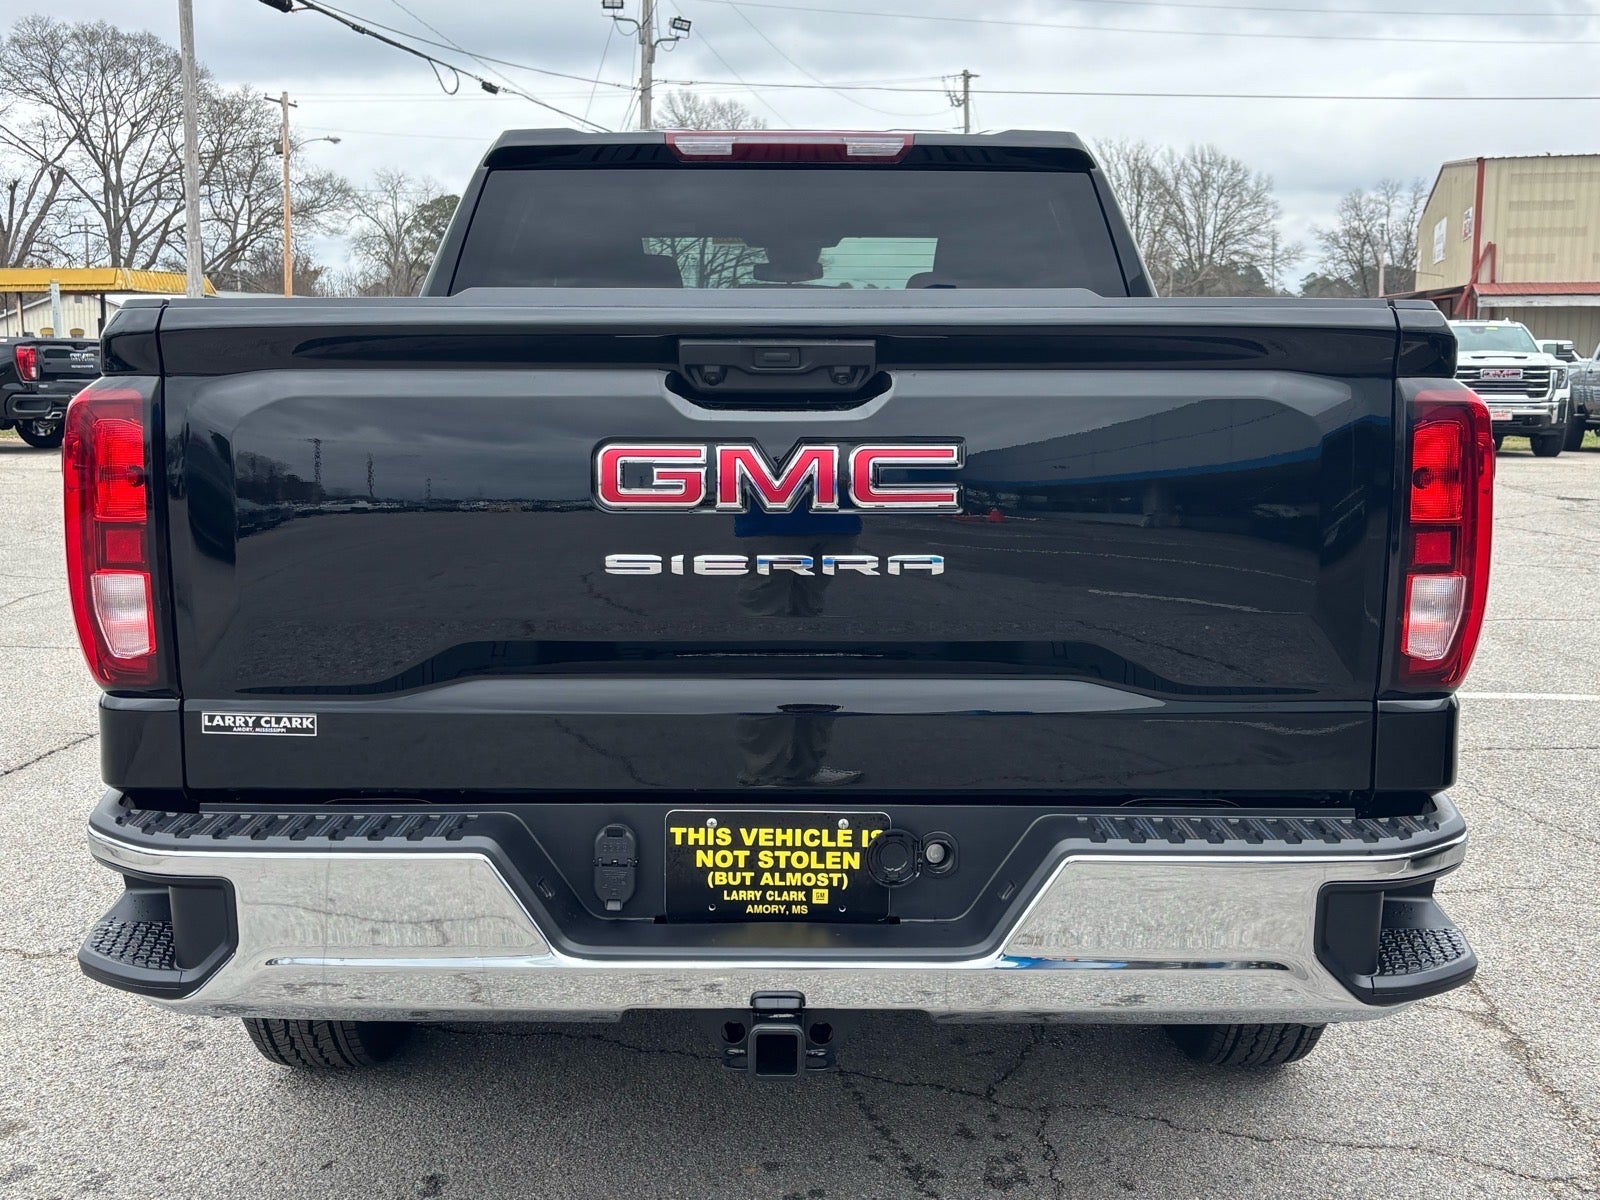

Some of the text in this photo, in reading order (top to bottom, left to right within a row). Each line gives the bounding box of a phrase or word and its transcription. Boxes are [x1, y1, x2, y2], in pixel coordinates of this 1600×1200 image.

[597, 443, 964, 510] GMC
[604, 553, 946, 577] SIERRA
[204, 715, 315, 728] LARRY CLARK
[670, 827, 732, 846] THIS
[740, 828, 853, 847] VEHICLE
[696, 850, 861, 869] NOT STOLEN
[707, 871, 849, 889] (BUT ALMOST)
[723, 890, 762, 902] LARRY
[766, 890, 807, 902] CLARK
[745, 904, 808, 916] AMORY, MS
